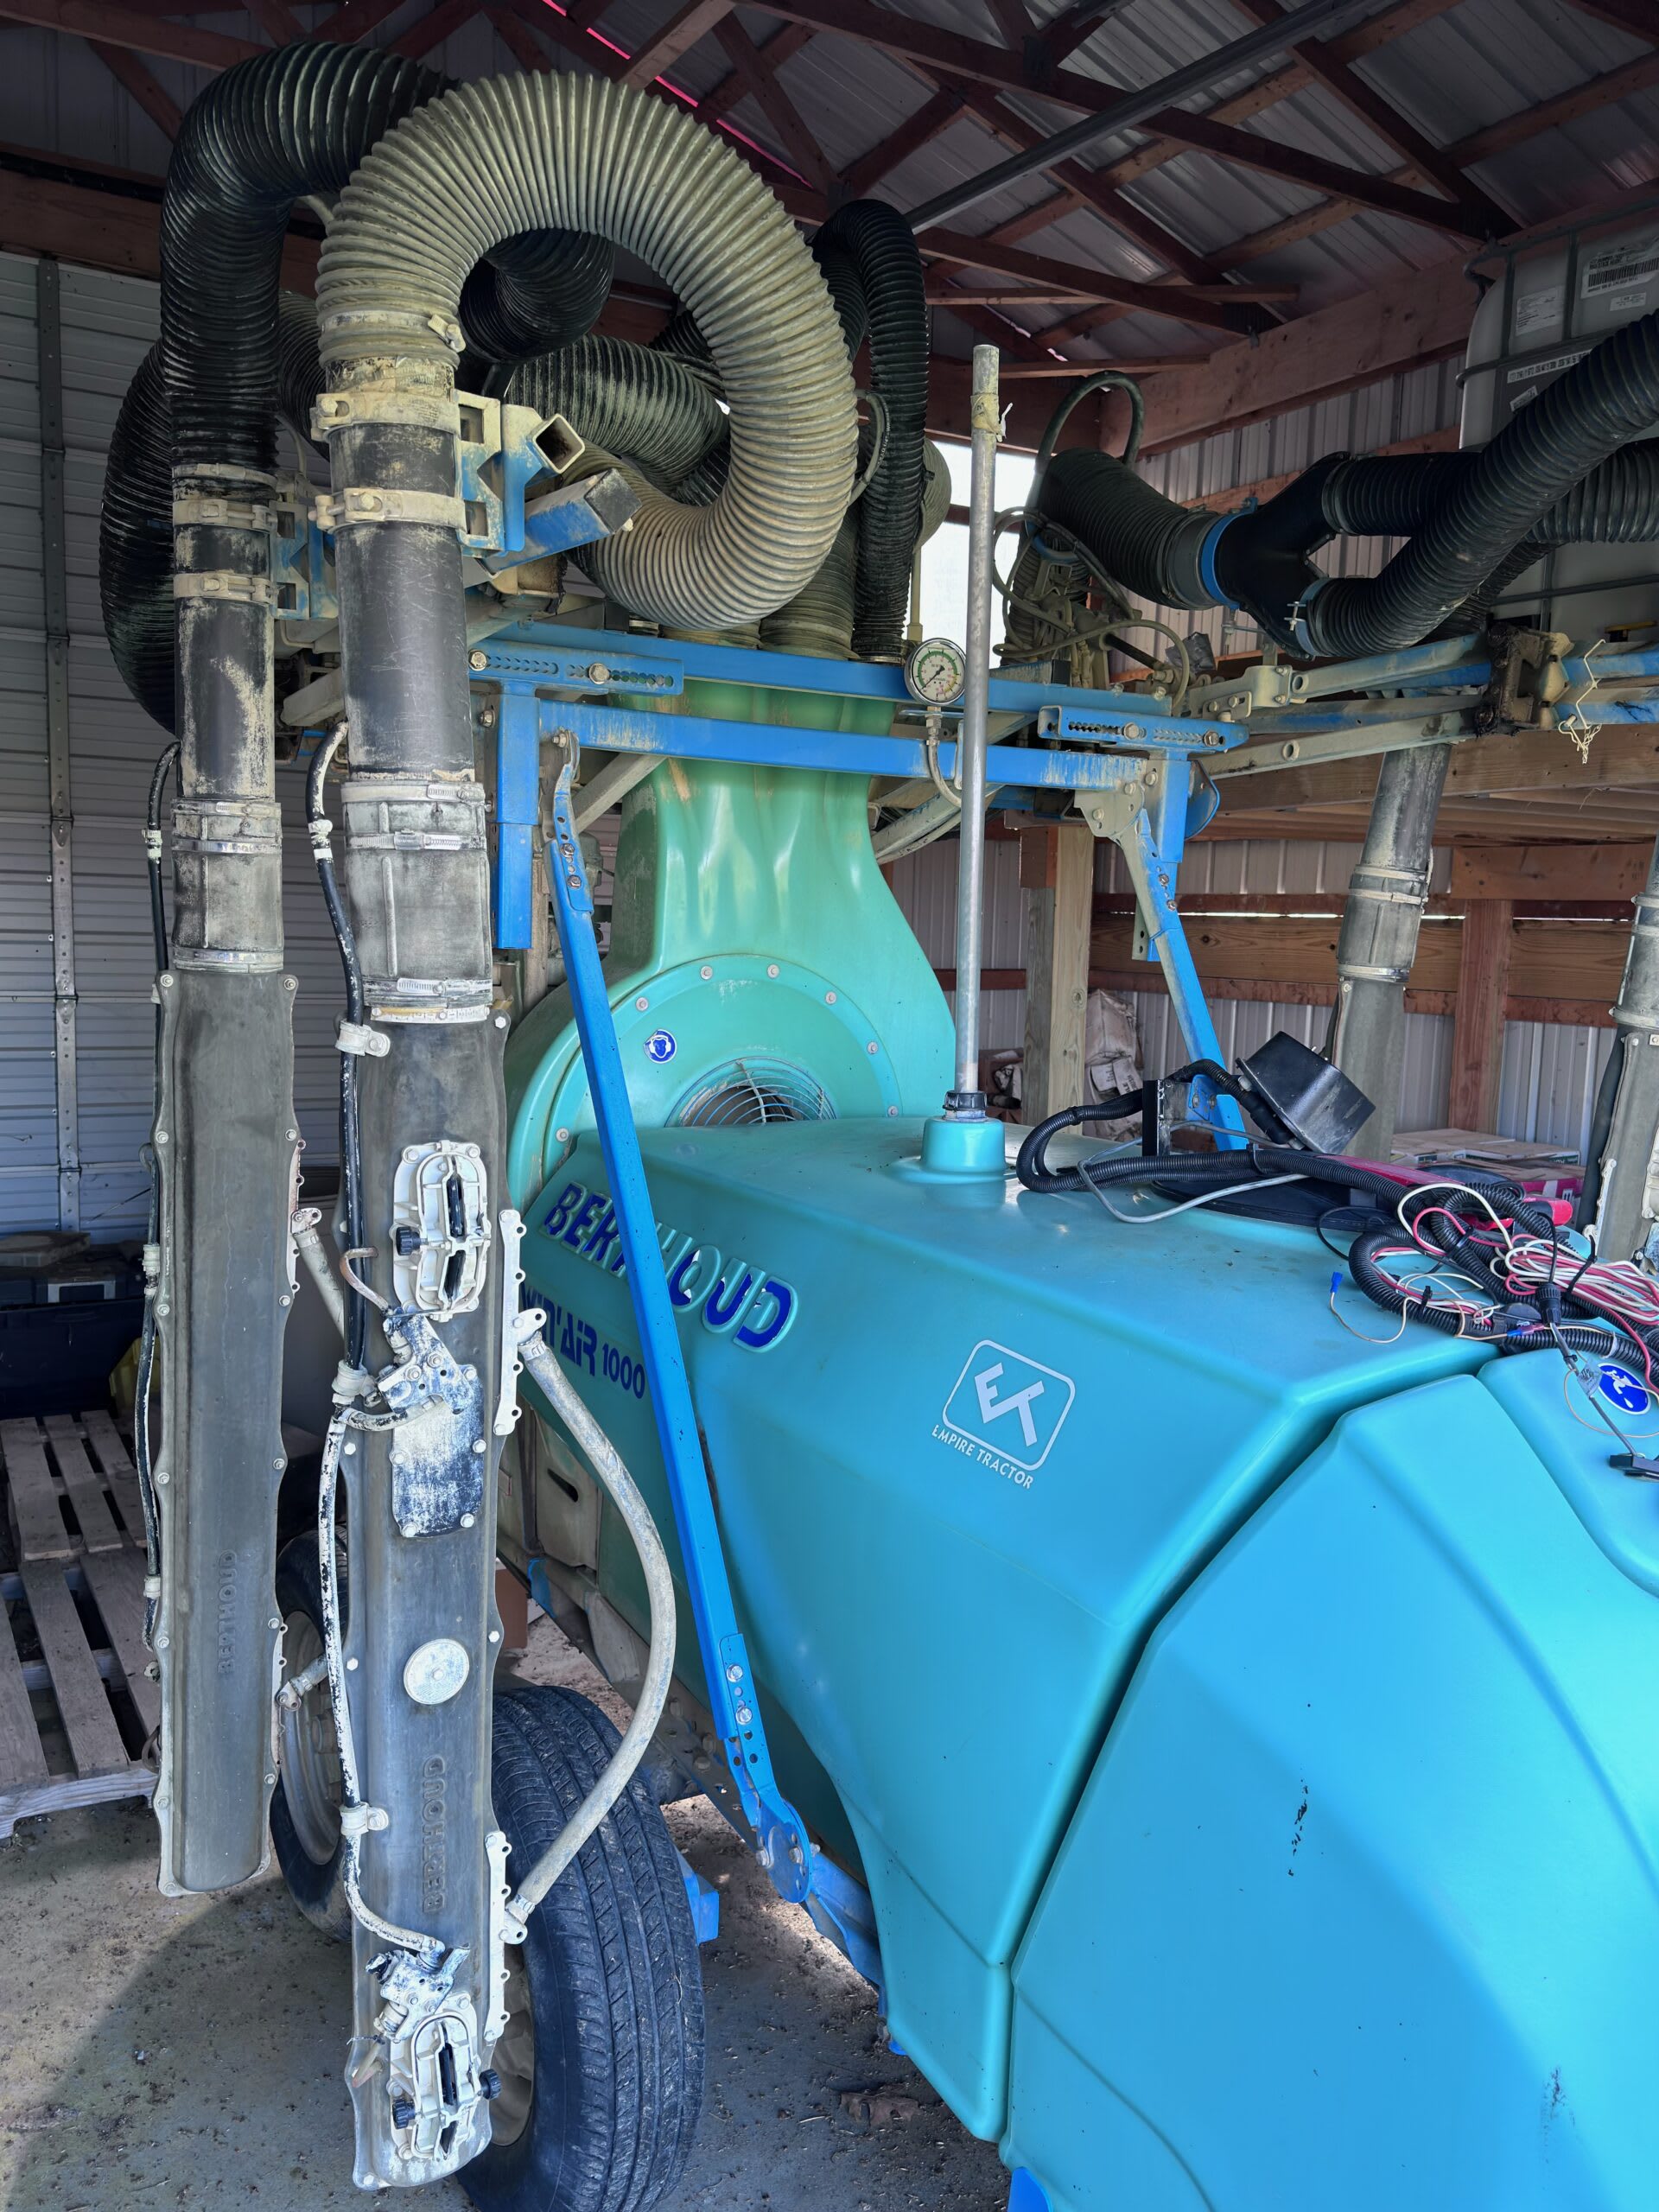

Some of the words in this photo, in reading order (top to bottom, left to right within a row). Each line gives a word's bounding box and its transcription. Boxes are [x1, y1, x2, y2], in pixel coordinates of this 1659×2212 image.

[601, 1344, 645, 1399] 1000
[931, 1424, 976, 1456] EMPIRE
[976, 1448, 1033, 1489] TRACTOR
[218, 1549, 238, 1674] BERTHOUD
[423, 1754, 446, 1913] BERTHOUD
